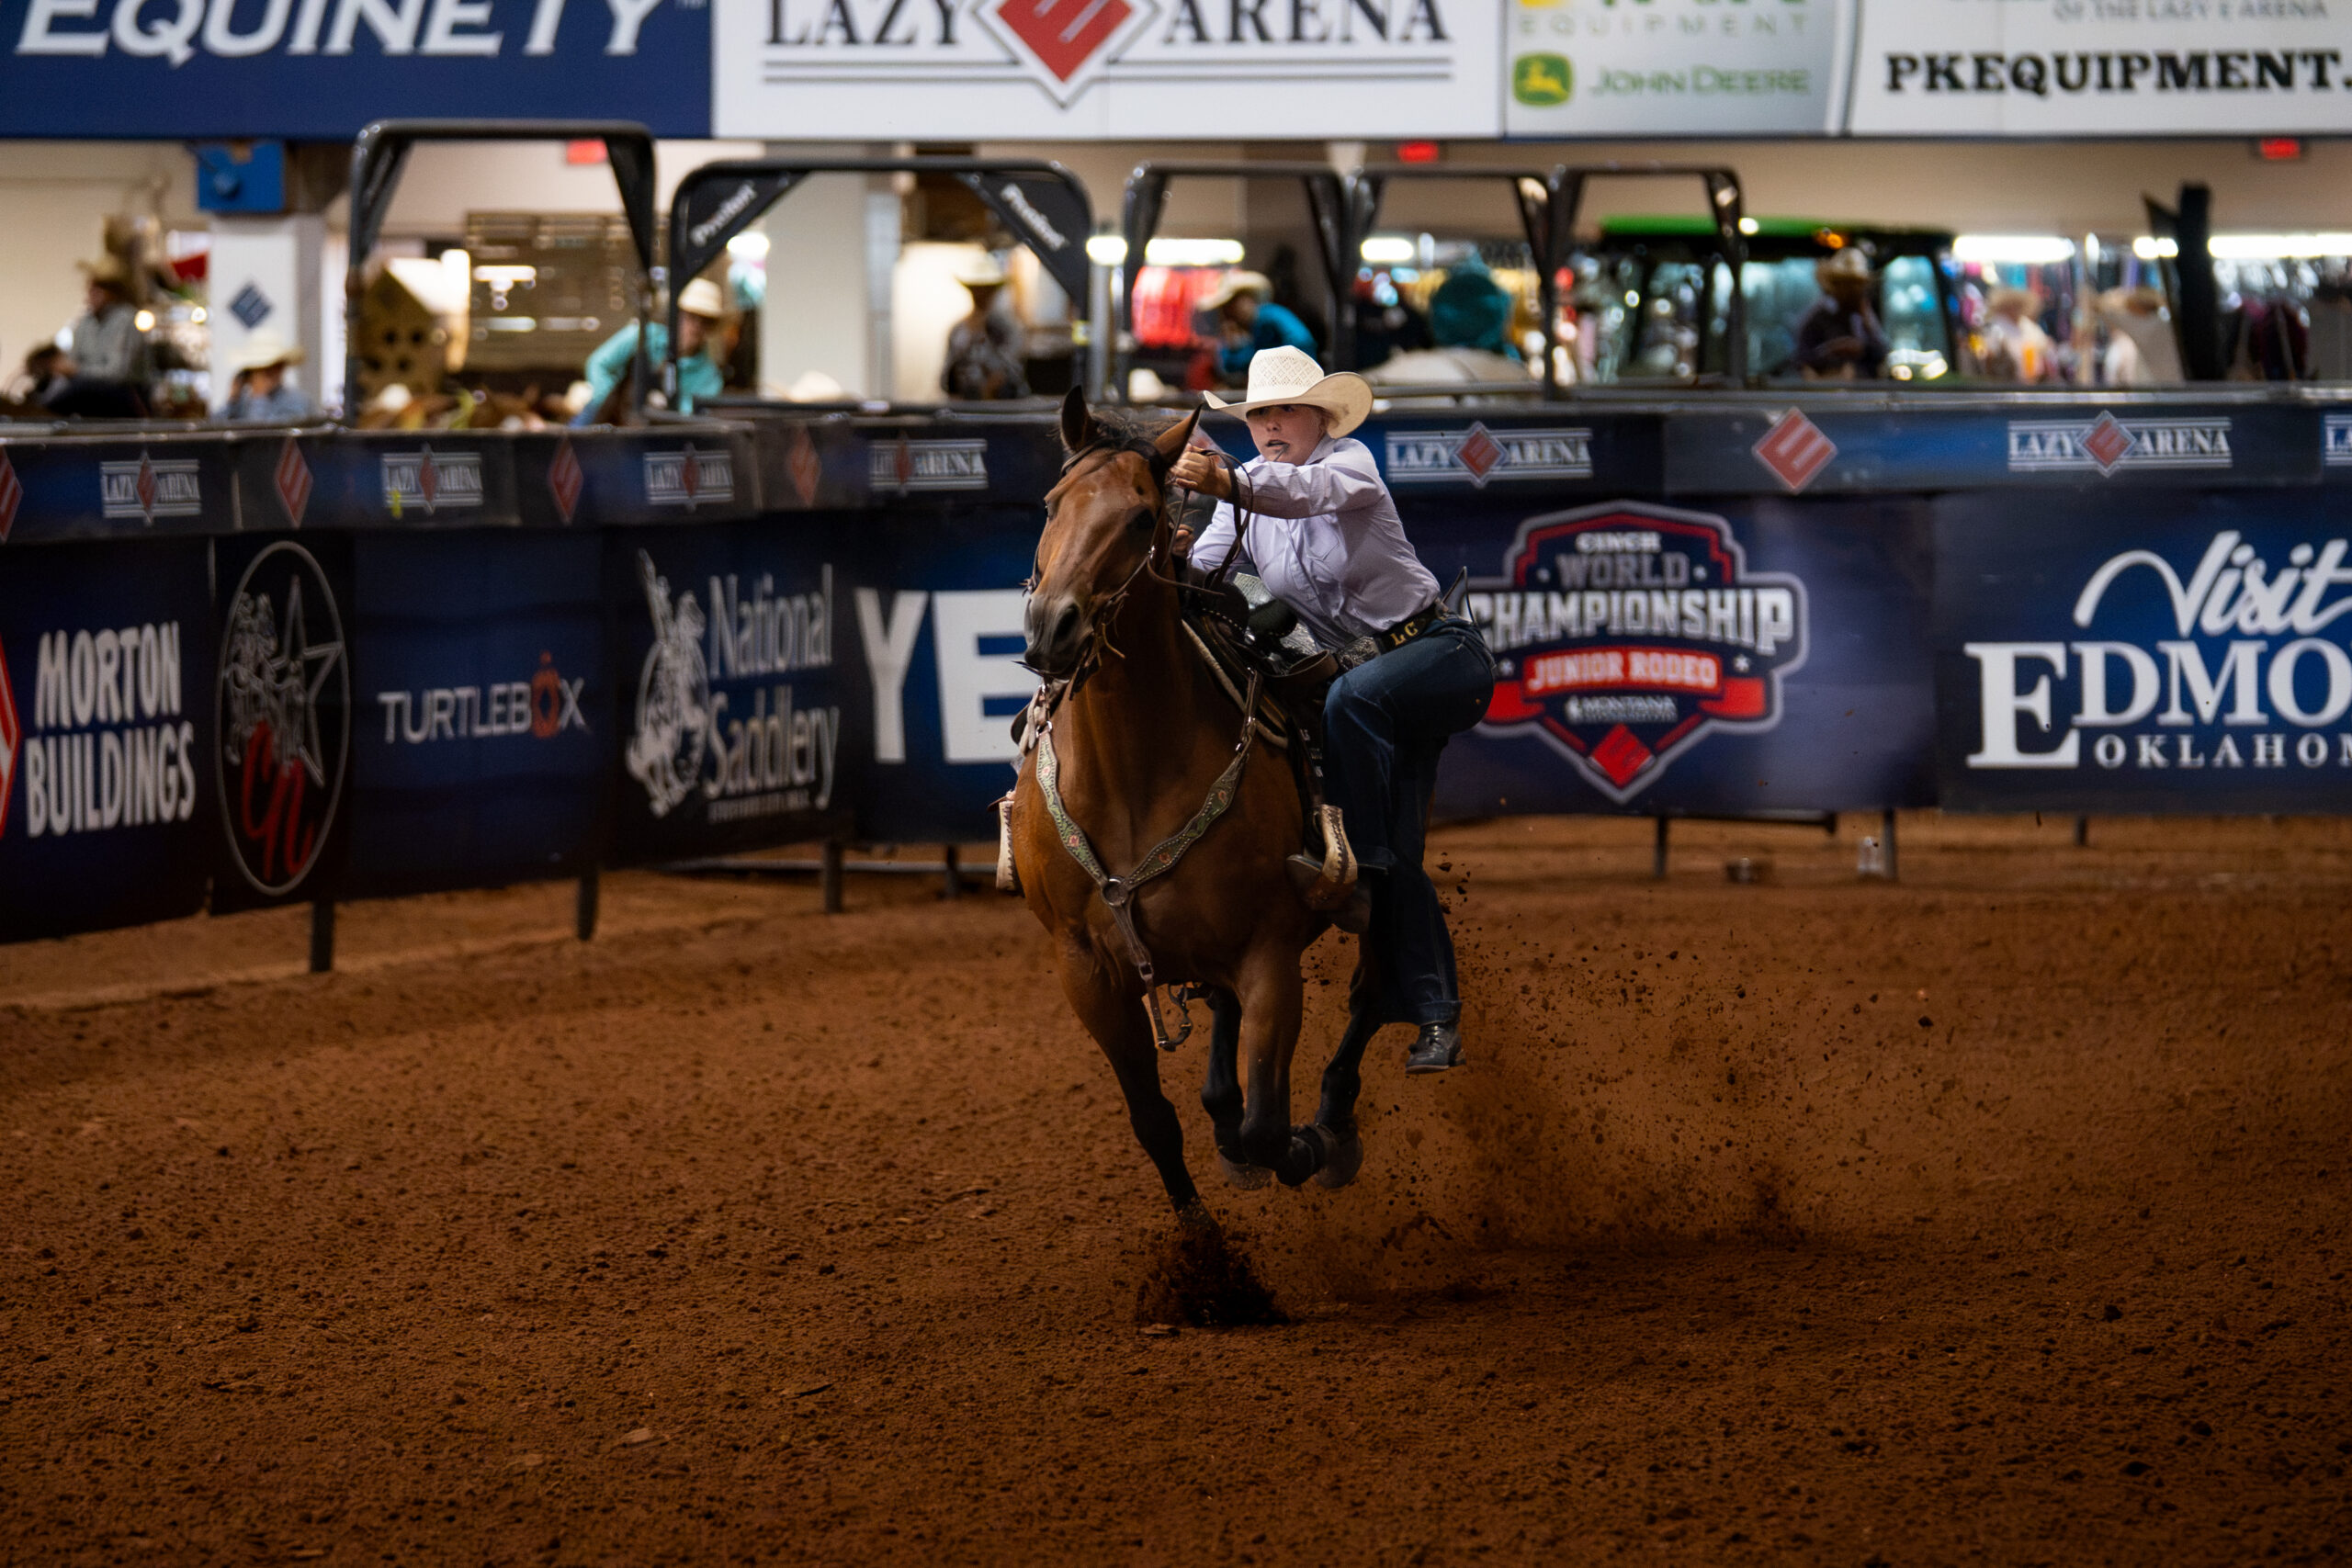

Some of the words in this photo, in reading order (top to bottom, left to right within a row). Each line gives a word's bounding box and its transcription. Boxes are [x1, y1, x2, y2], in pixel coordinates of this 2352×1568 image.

[764, 0, 962, 46] LAZY
[1159, 0, 1452, 44] ARENA
[1518, 13, 1808, 37] EQUIPMENT
[1591, 65, 1687, 96] JOHN
[1690, 64, 1810, 94] DEERE
[1507, 439, 1592, 464] ARENA
[2008, 430, 2078, 457] LAZY
[2134, 428, 2231, 455] ARENA
[1555, 550, 1690, 591] WORLD
[2074, 530, 2352, 637] Visit
[709, 563, 832, 681] National
[1460, 587, 1792, 655] CHAMPIONSHIP
[35, 621, 182, 729] MORTON
[1526, 651, 1625, 691] JUNIOR
[1628, 650, 1720, 689] RODEO
[377, 667, 588, 745] TURTLEBOX
[704, 684, 840, 811] Saddlery
[25, 721, 196, 838] BUILDINGS
